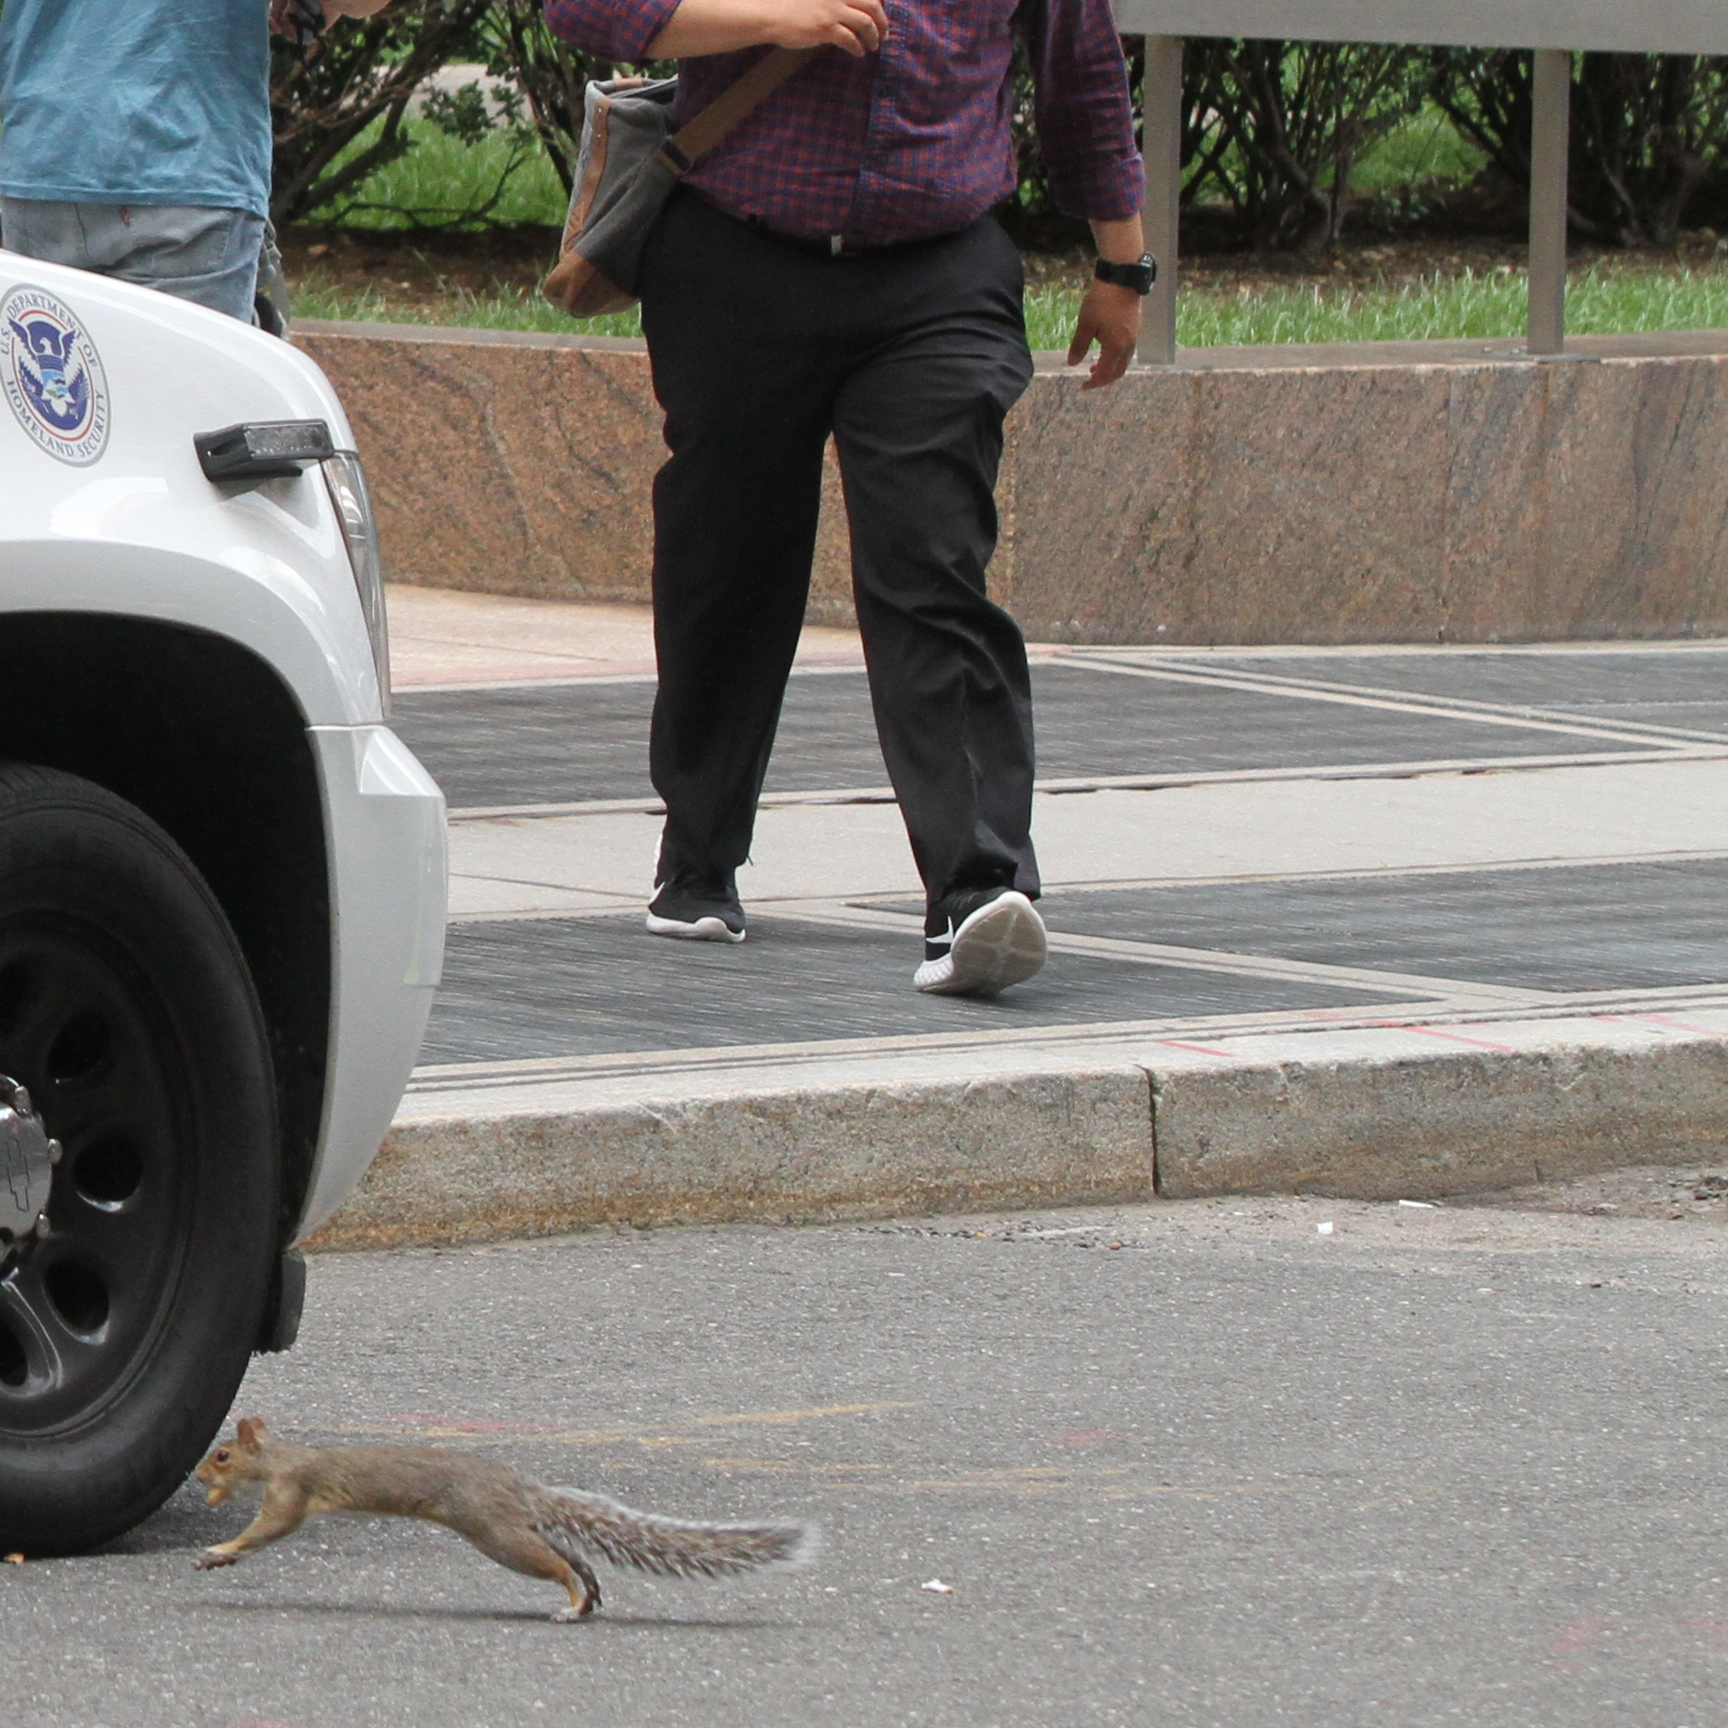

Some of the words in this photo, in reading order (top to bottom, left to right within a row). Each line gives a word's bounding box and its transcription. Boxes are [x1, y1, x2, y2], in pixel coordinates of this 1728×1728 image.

[5, 292, 83, 340] DEPARTMENT
[0, 327, 12, 356] U.S.
[83, 343, 99, 368] OF
[6, 379, 75, 458] HOMELAND
[77, 388, 106, 458] SECURITY
